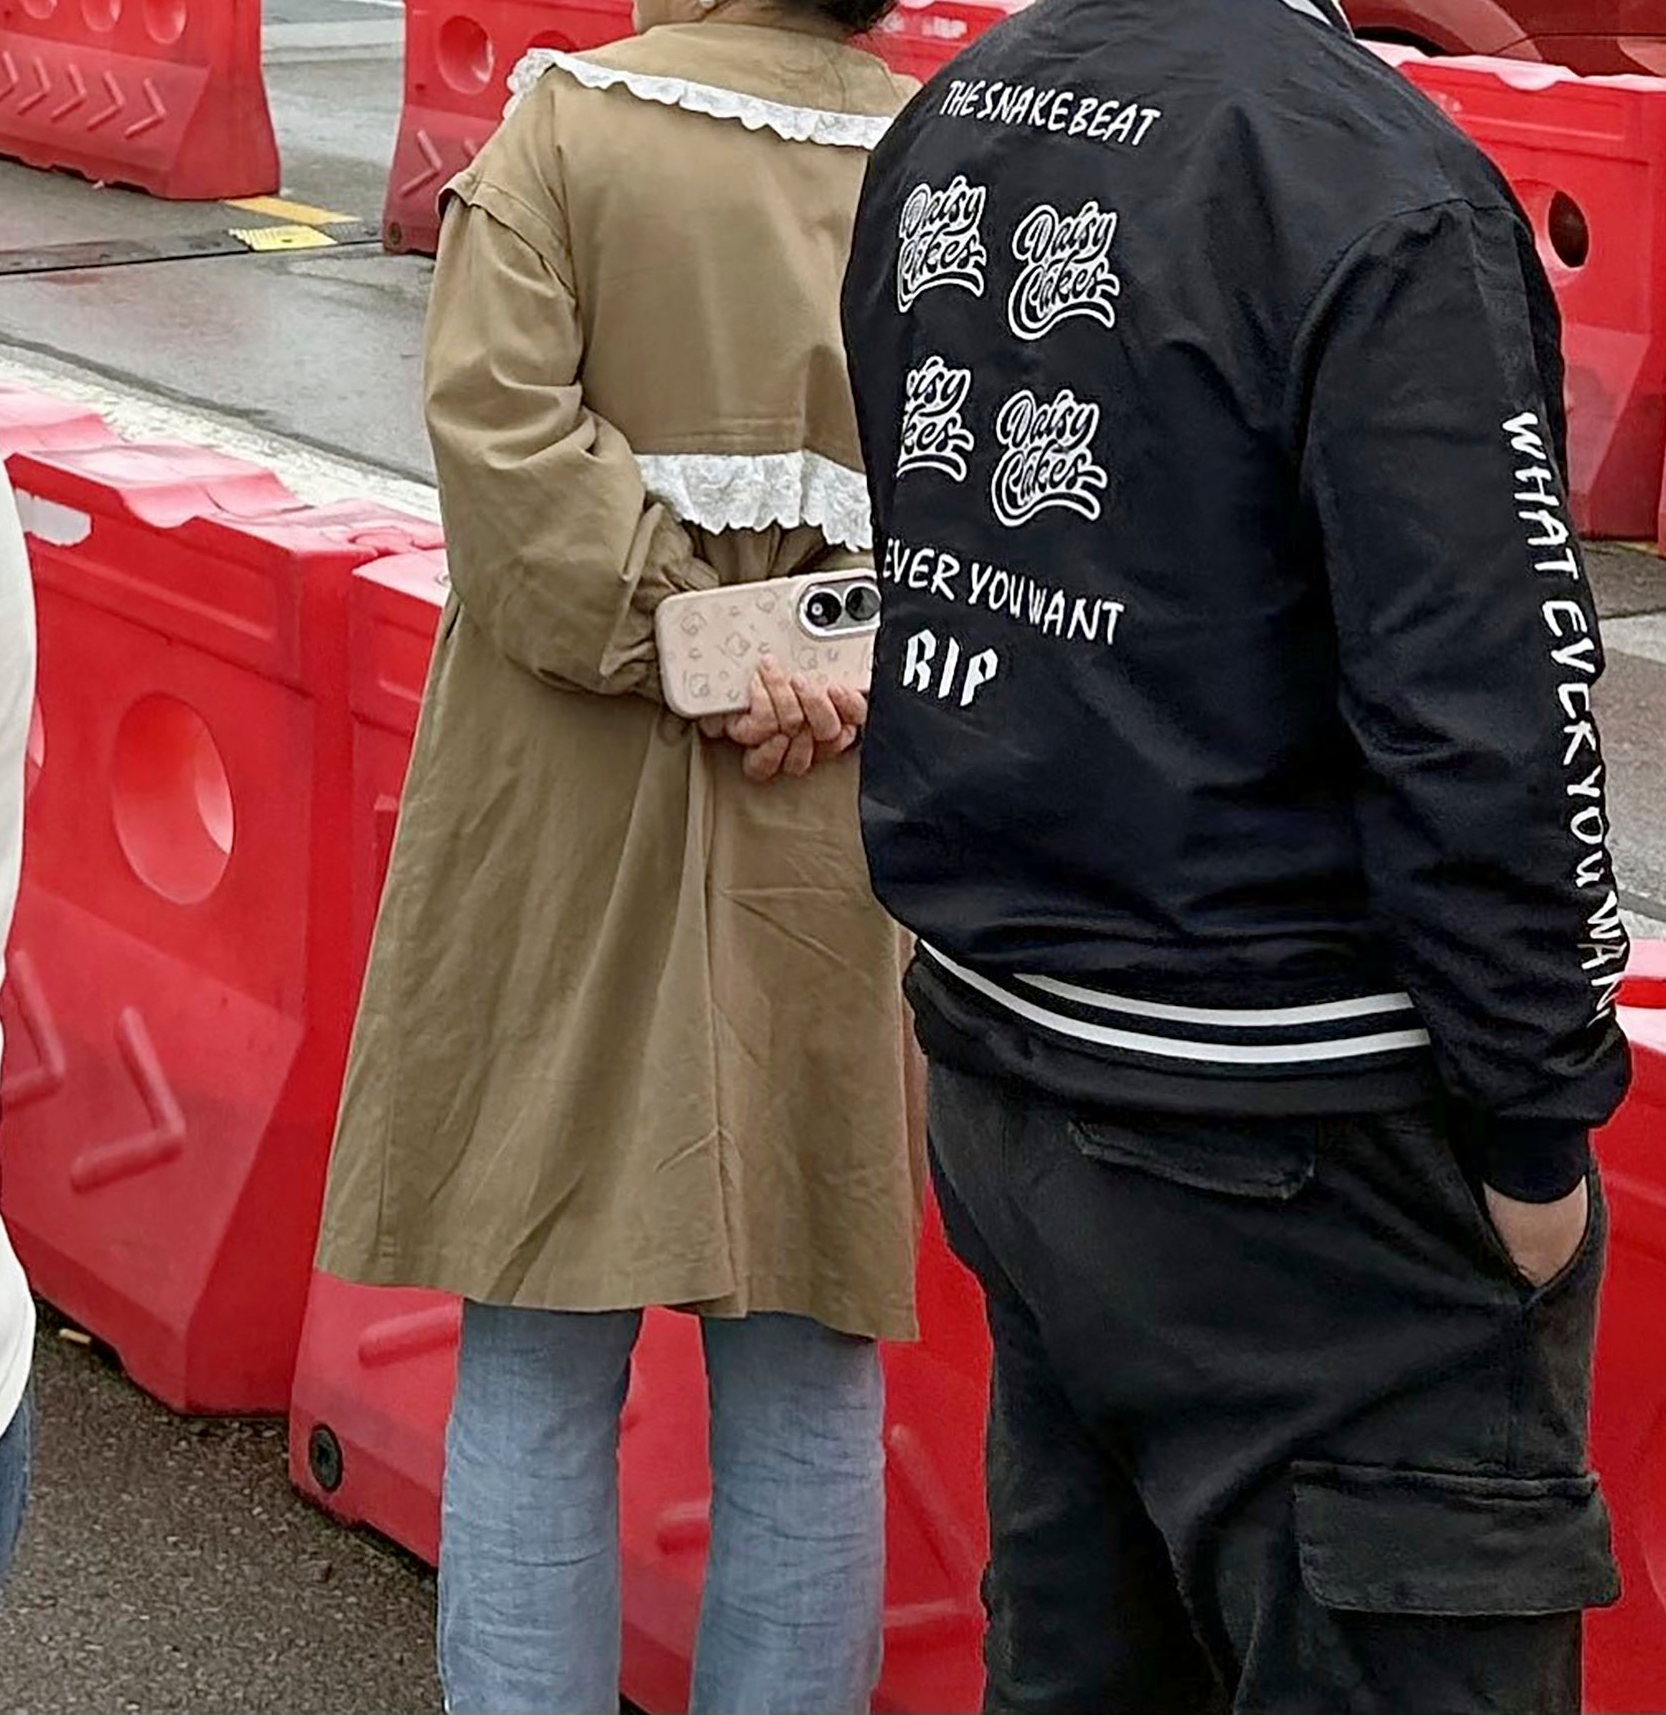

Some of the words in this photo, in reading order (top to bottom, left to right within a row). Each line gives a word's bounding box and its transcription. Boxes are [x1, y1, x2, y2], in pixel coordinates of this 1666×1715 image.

[1067, 96, 1161, 147] BEAT
[1012, 201, 1117, 266] Daisy
[996, 389, 1100, 452] Daisy
[1501, 411, 1580, 581] WHAT
[902, 628, 999, 707] RIP
